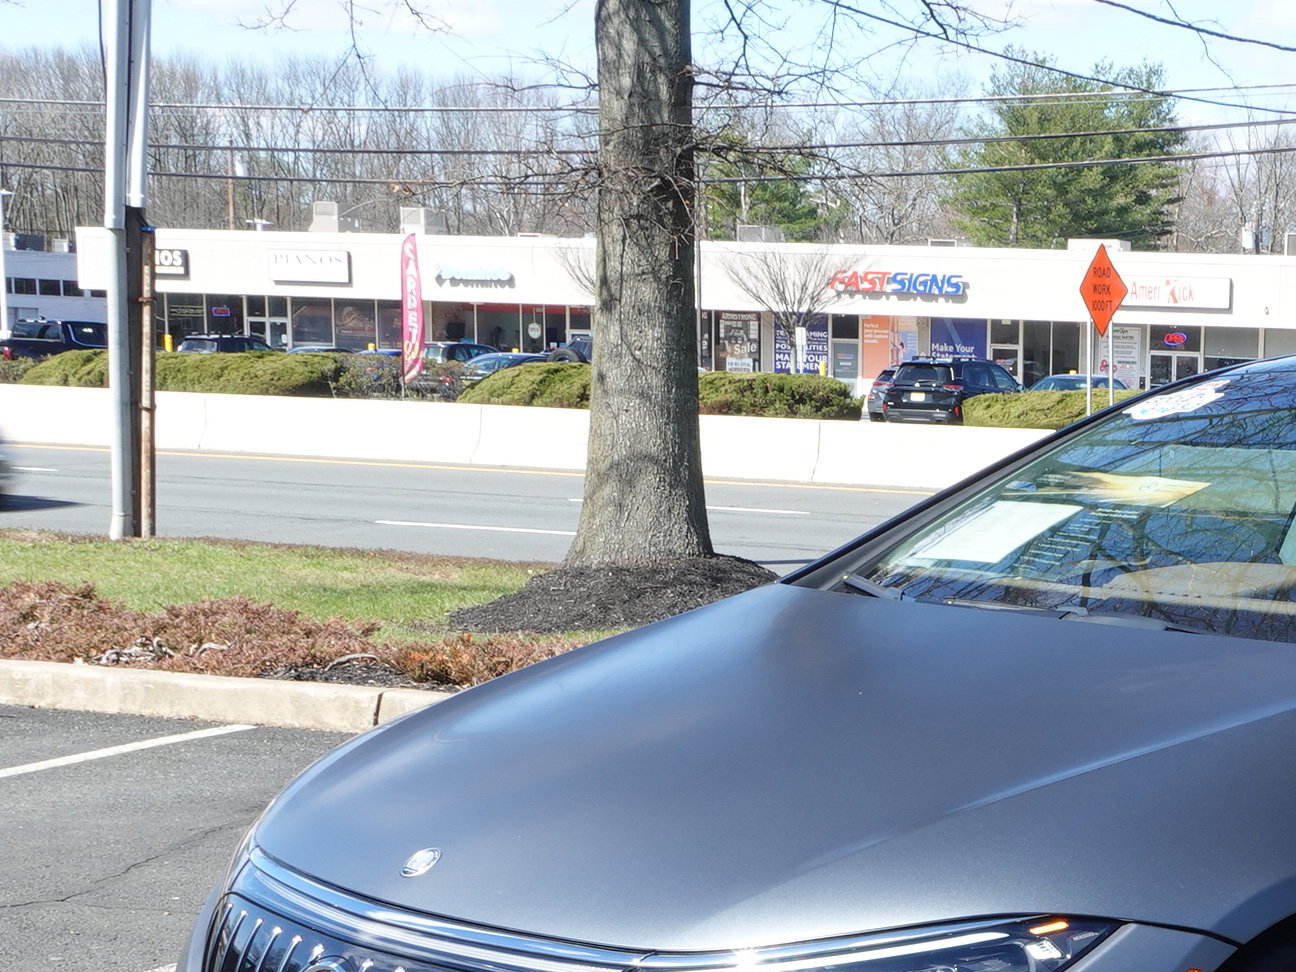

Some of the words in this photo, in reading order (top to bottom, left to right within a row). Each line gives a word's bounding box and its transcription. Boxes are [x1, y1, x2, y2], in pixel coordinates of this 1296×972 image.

[274, 253, 342, 264] PIANOS
[1092, 266, 1111, 278] ROAD
[829, 271, 963, 296] FASTSIGNS
[1092, 283, 1111, 295] WORK
[733, 343, 757, 355] Sale
[931, 343, 954, 352] Make
[955, 344, 975, 353] Your
